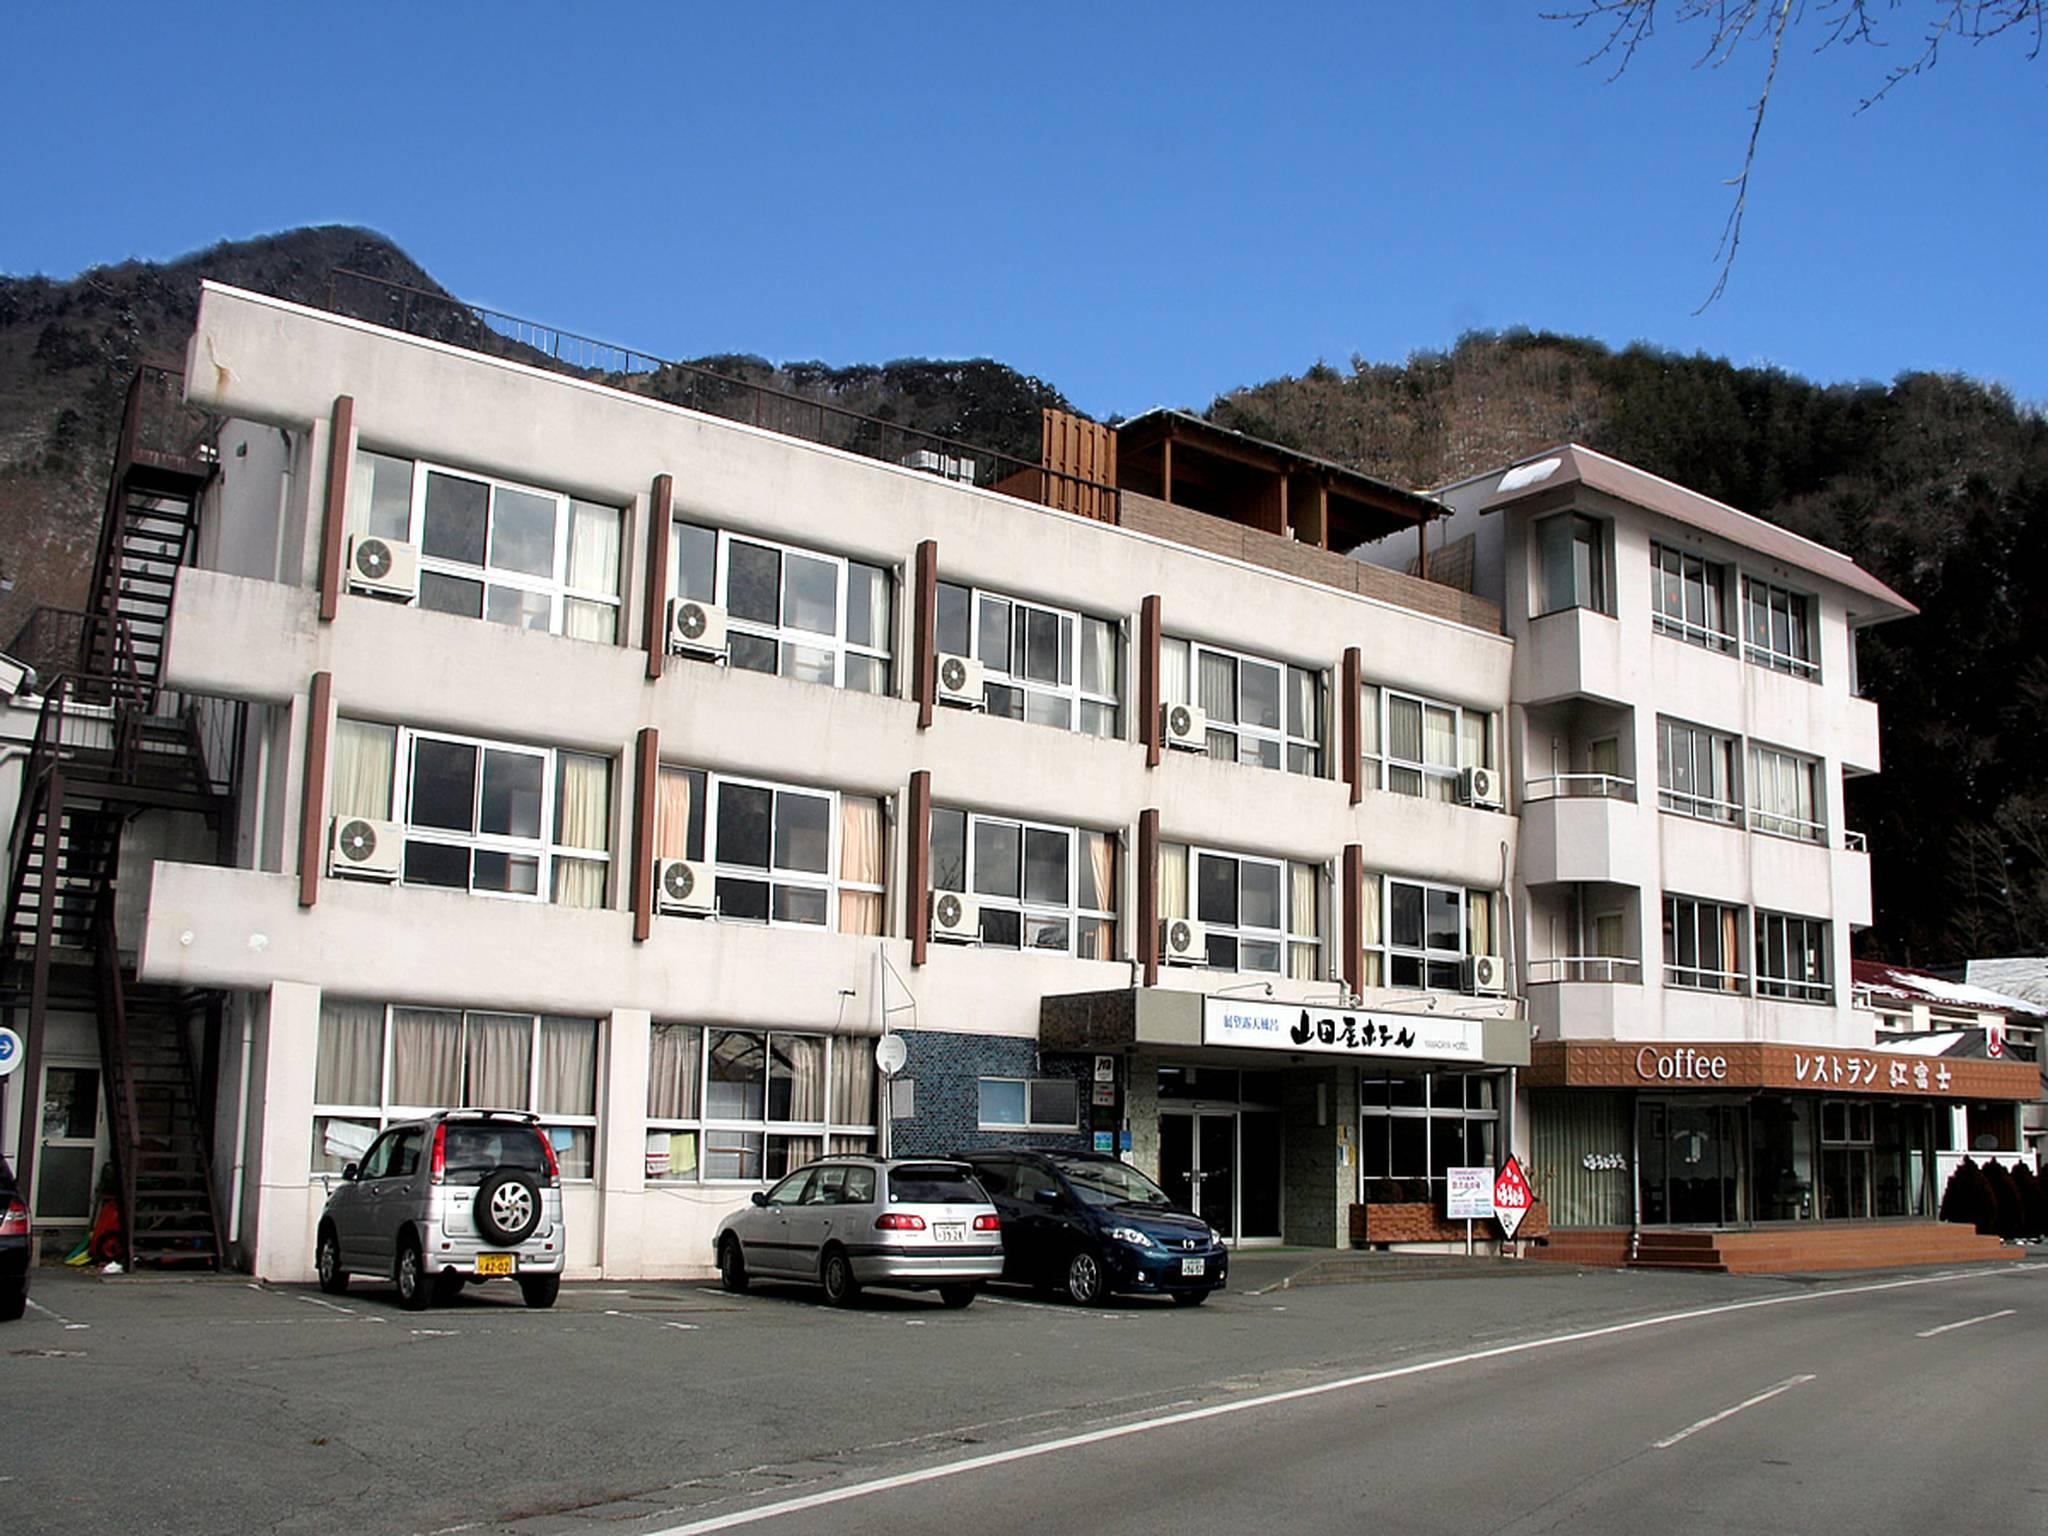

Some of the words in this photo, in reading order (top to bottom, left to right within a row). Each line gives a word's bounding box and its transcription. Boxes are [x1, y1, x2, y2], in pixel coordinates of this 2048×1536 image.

[1290, 1009, 1415, 1048] 山田屋ホテル
[1636, 1046, 1727, 1079] Coffee
[1794, 1053, 1878, 1084] レストラン
[1889, 1059, 1951, 1090] 紅富士
